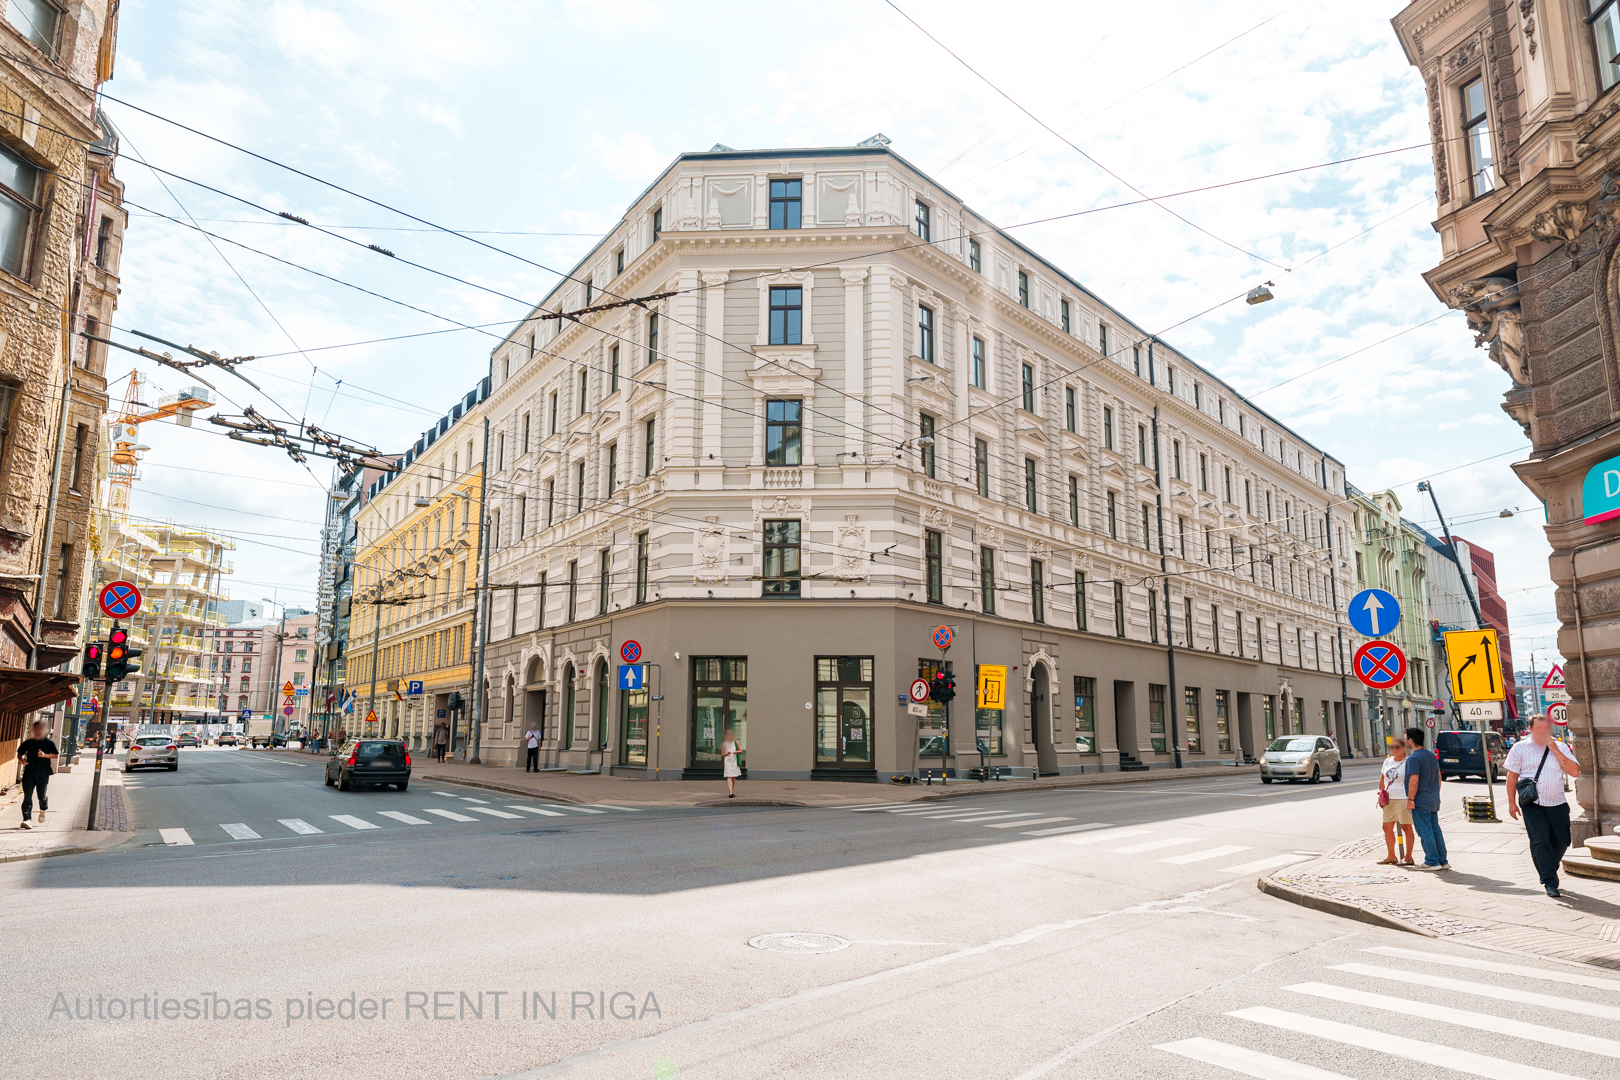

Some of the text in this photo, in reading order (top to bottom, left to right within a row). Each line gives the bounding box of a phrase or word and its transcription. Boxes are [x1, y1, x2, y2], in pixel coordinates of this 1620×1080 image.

[320, 518, 339, 627] TALLINK Hotels
[411, 682, 420, 693] P
[1470, 707, 1482, 716] 40
[1553, 709, 1567, 720] 30
